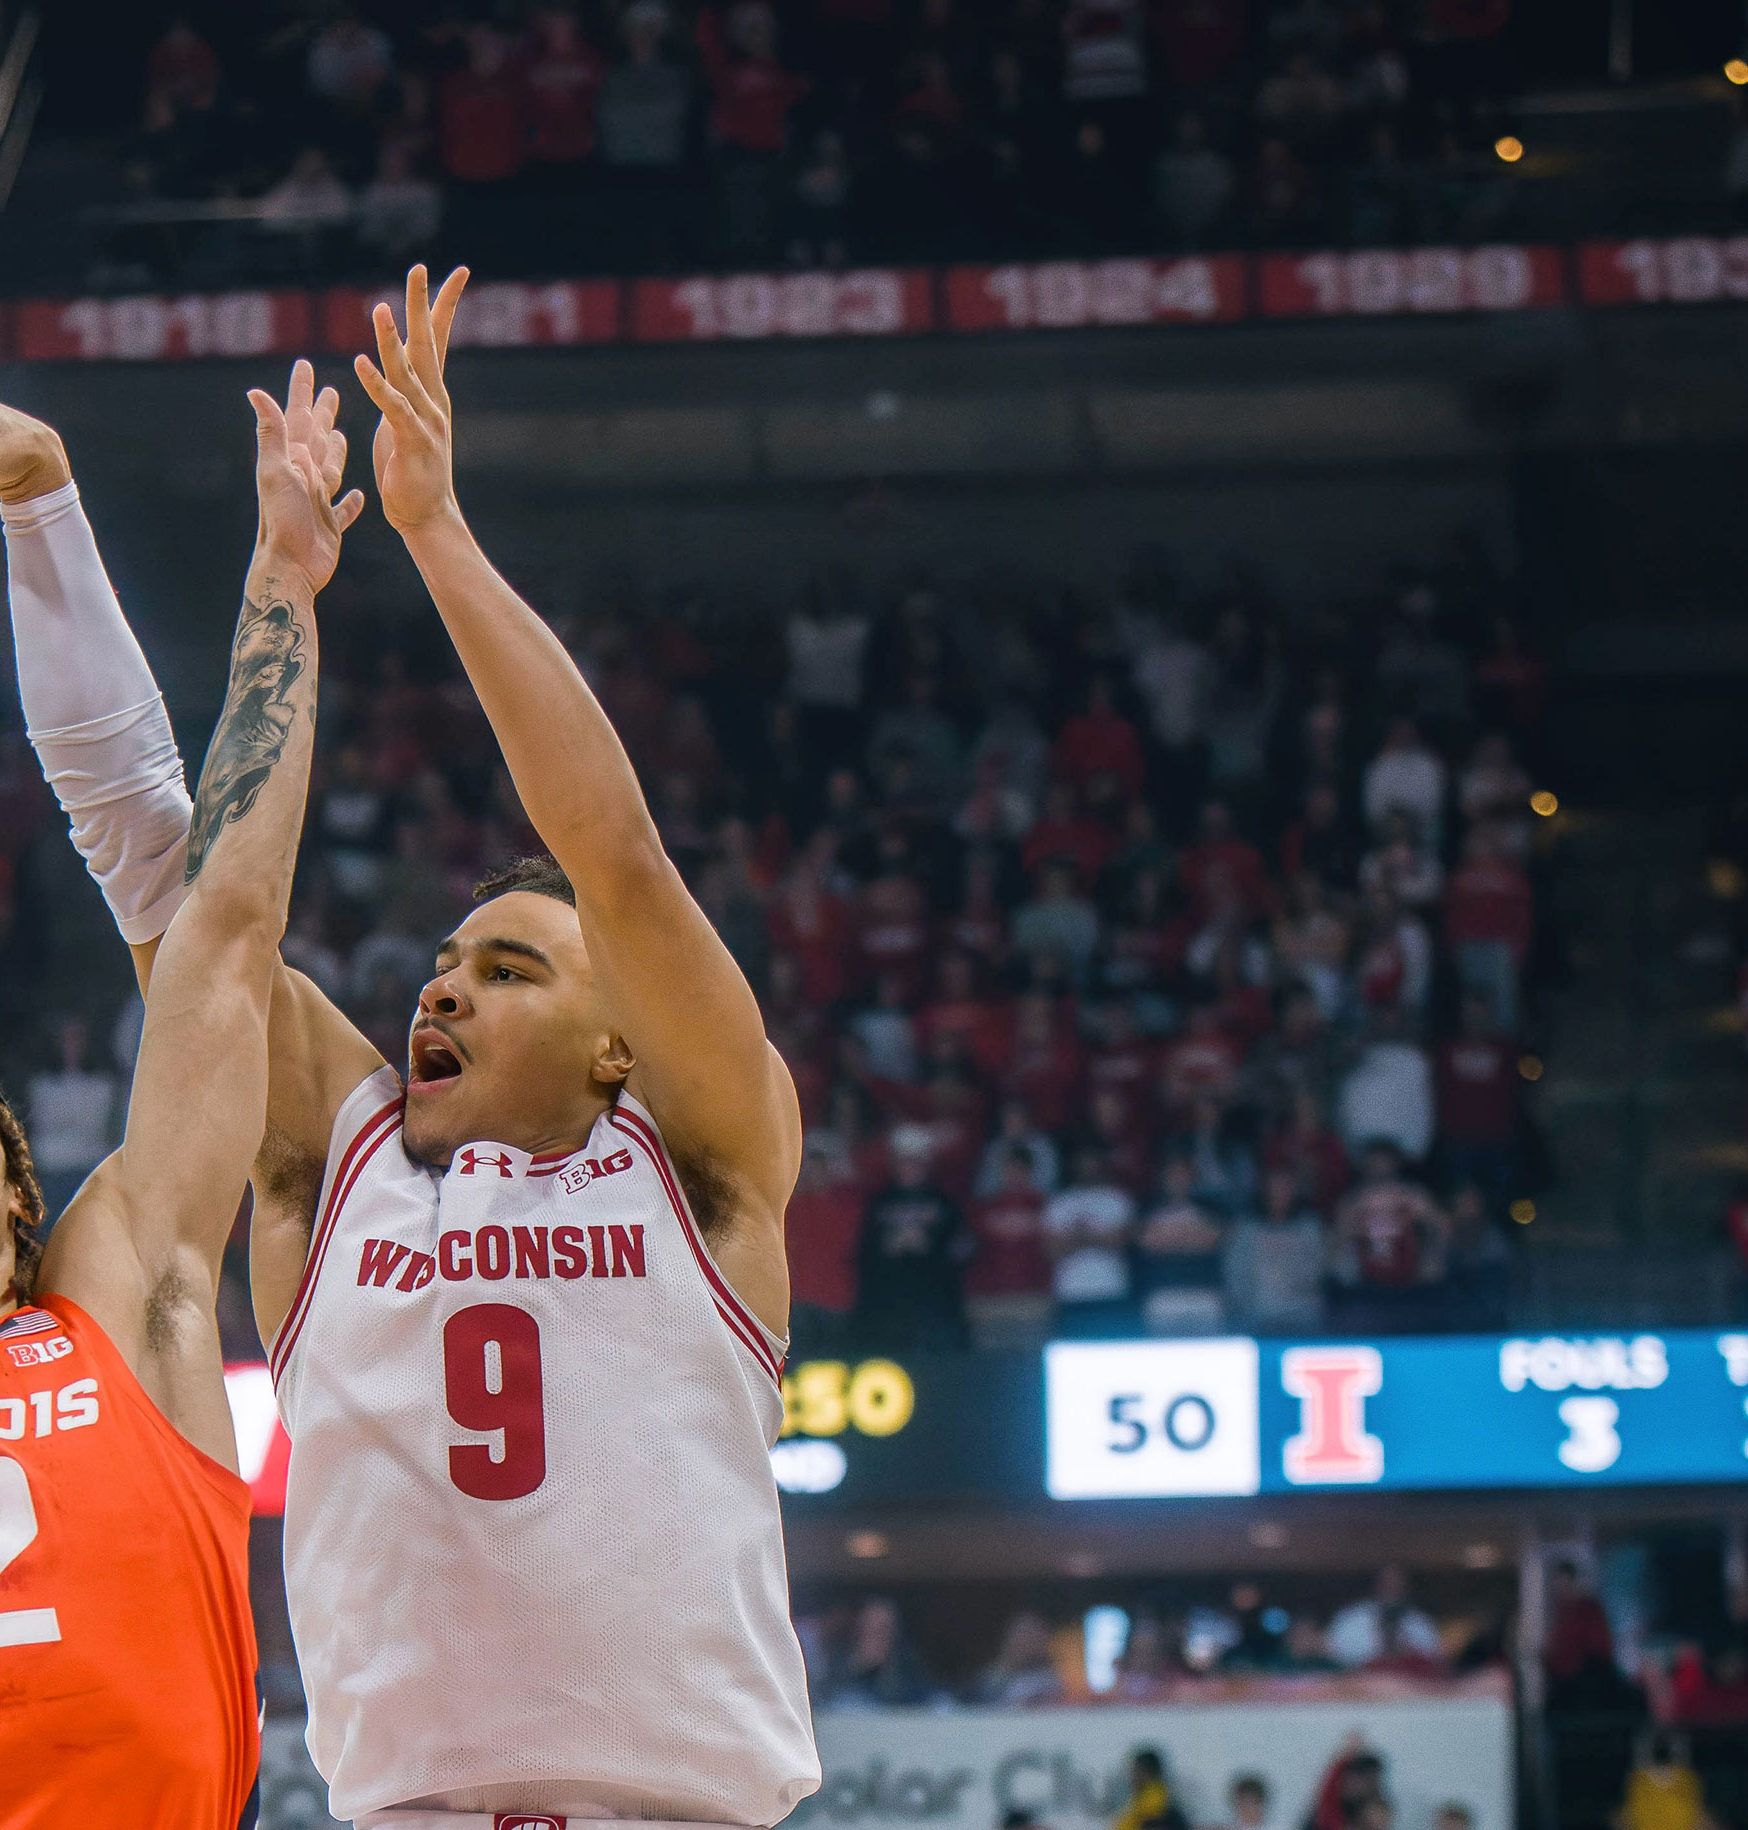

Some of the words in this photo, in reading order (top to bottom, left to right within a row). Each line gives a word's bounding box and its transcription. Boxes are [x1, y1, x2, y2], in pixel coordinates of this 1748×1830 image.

[1499, 1335, 1669, 1392] FOULS
[443, 1303, 546, 1501] 9
[1107, 1393, 1217, 1454] 50
[1558, 1396, 1621, 1472] 3
[992, 1747, 1142, 1815] Clu
